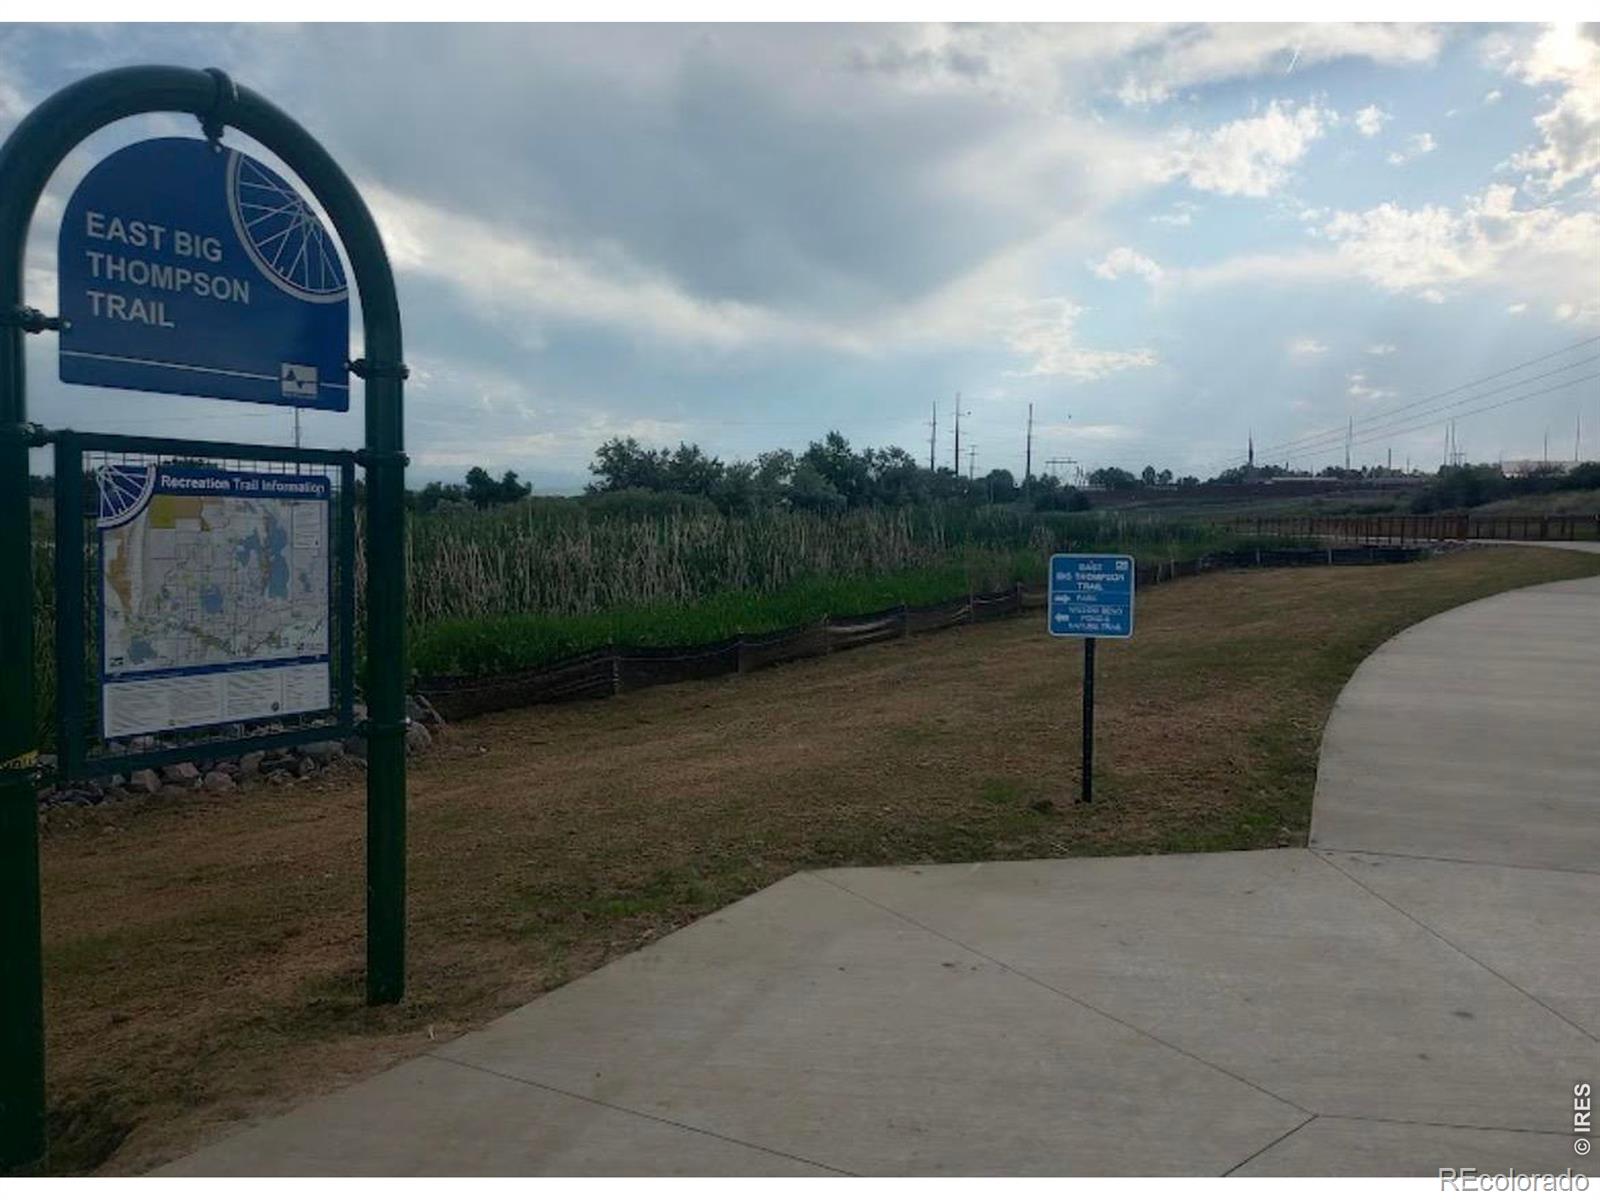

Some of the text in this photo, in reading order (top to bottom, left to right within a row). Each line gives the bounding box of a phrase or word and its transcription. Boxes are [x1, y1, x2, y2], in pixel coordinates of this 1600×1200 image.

[86, 211, 223, 262] EAST BIG
[86, 251, 250, 304] THOMPSON
[86, 291, 175, 328] TRAIL
[161, 475, 325, 494] Recreation Trail Information
[1056, 571, 1125, 581] BIG THOMPSON
[1078, 563, 1103, 571] EAST
[1076, 582, 1103, 591] TRAIL
